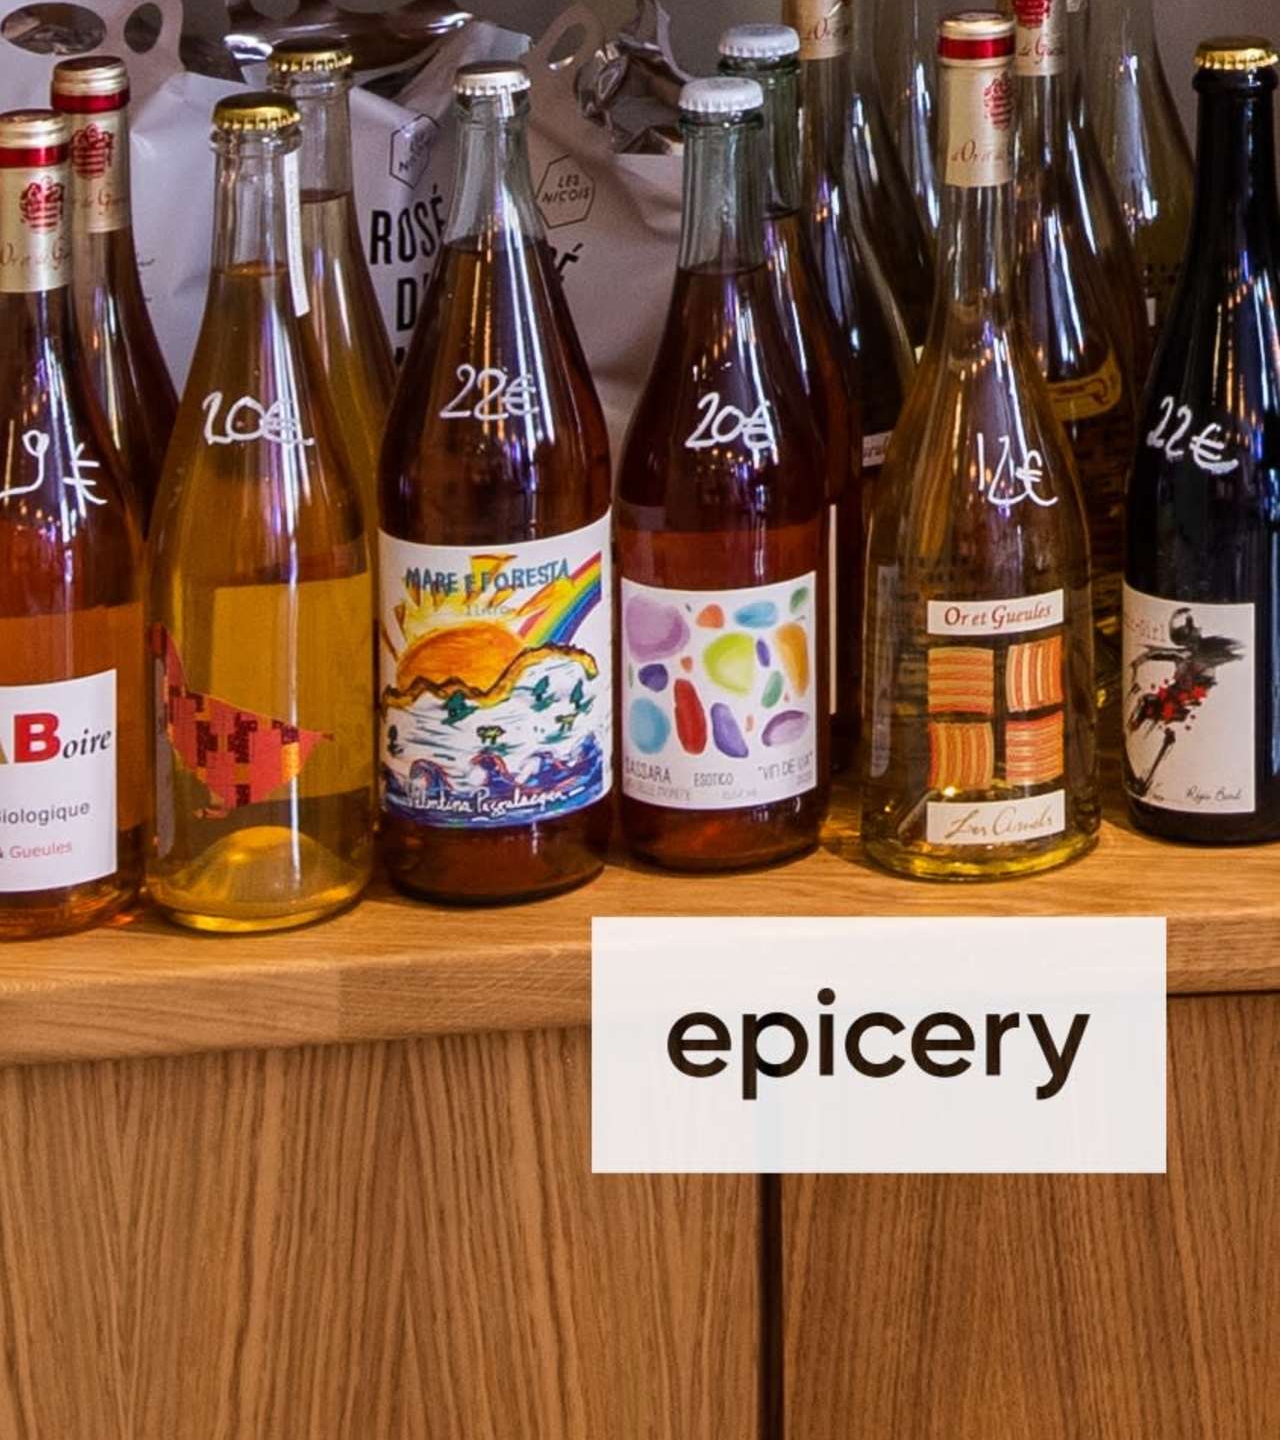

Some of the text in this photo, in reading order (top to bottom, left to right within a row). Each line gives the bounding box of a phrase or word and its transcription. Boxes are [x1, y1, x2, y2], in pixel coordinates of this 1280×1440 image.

[556, 174, 580, 190] LES
[439, 363, 540, 422] 22€
[202, 393, 315, 447] 20€
[685, 390, 777, 453] 20€
[1147, 393, 1239, 475] 22€
[405, 566, 459, 593] MARE
[479, 558, 570, 593] FORESTA
[943, 601, 1053, 629] Or et Gueules
[9, 840, 73, 859] Gueules
